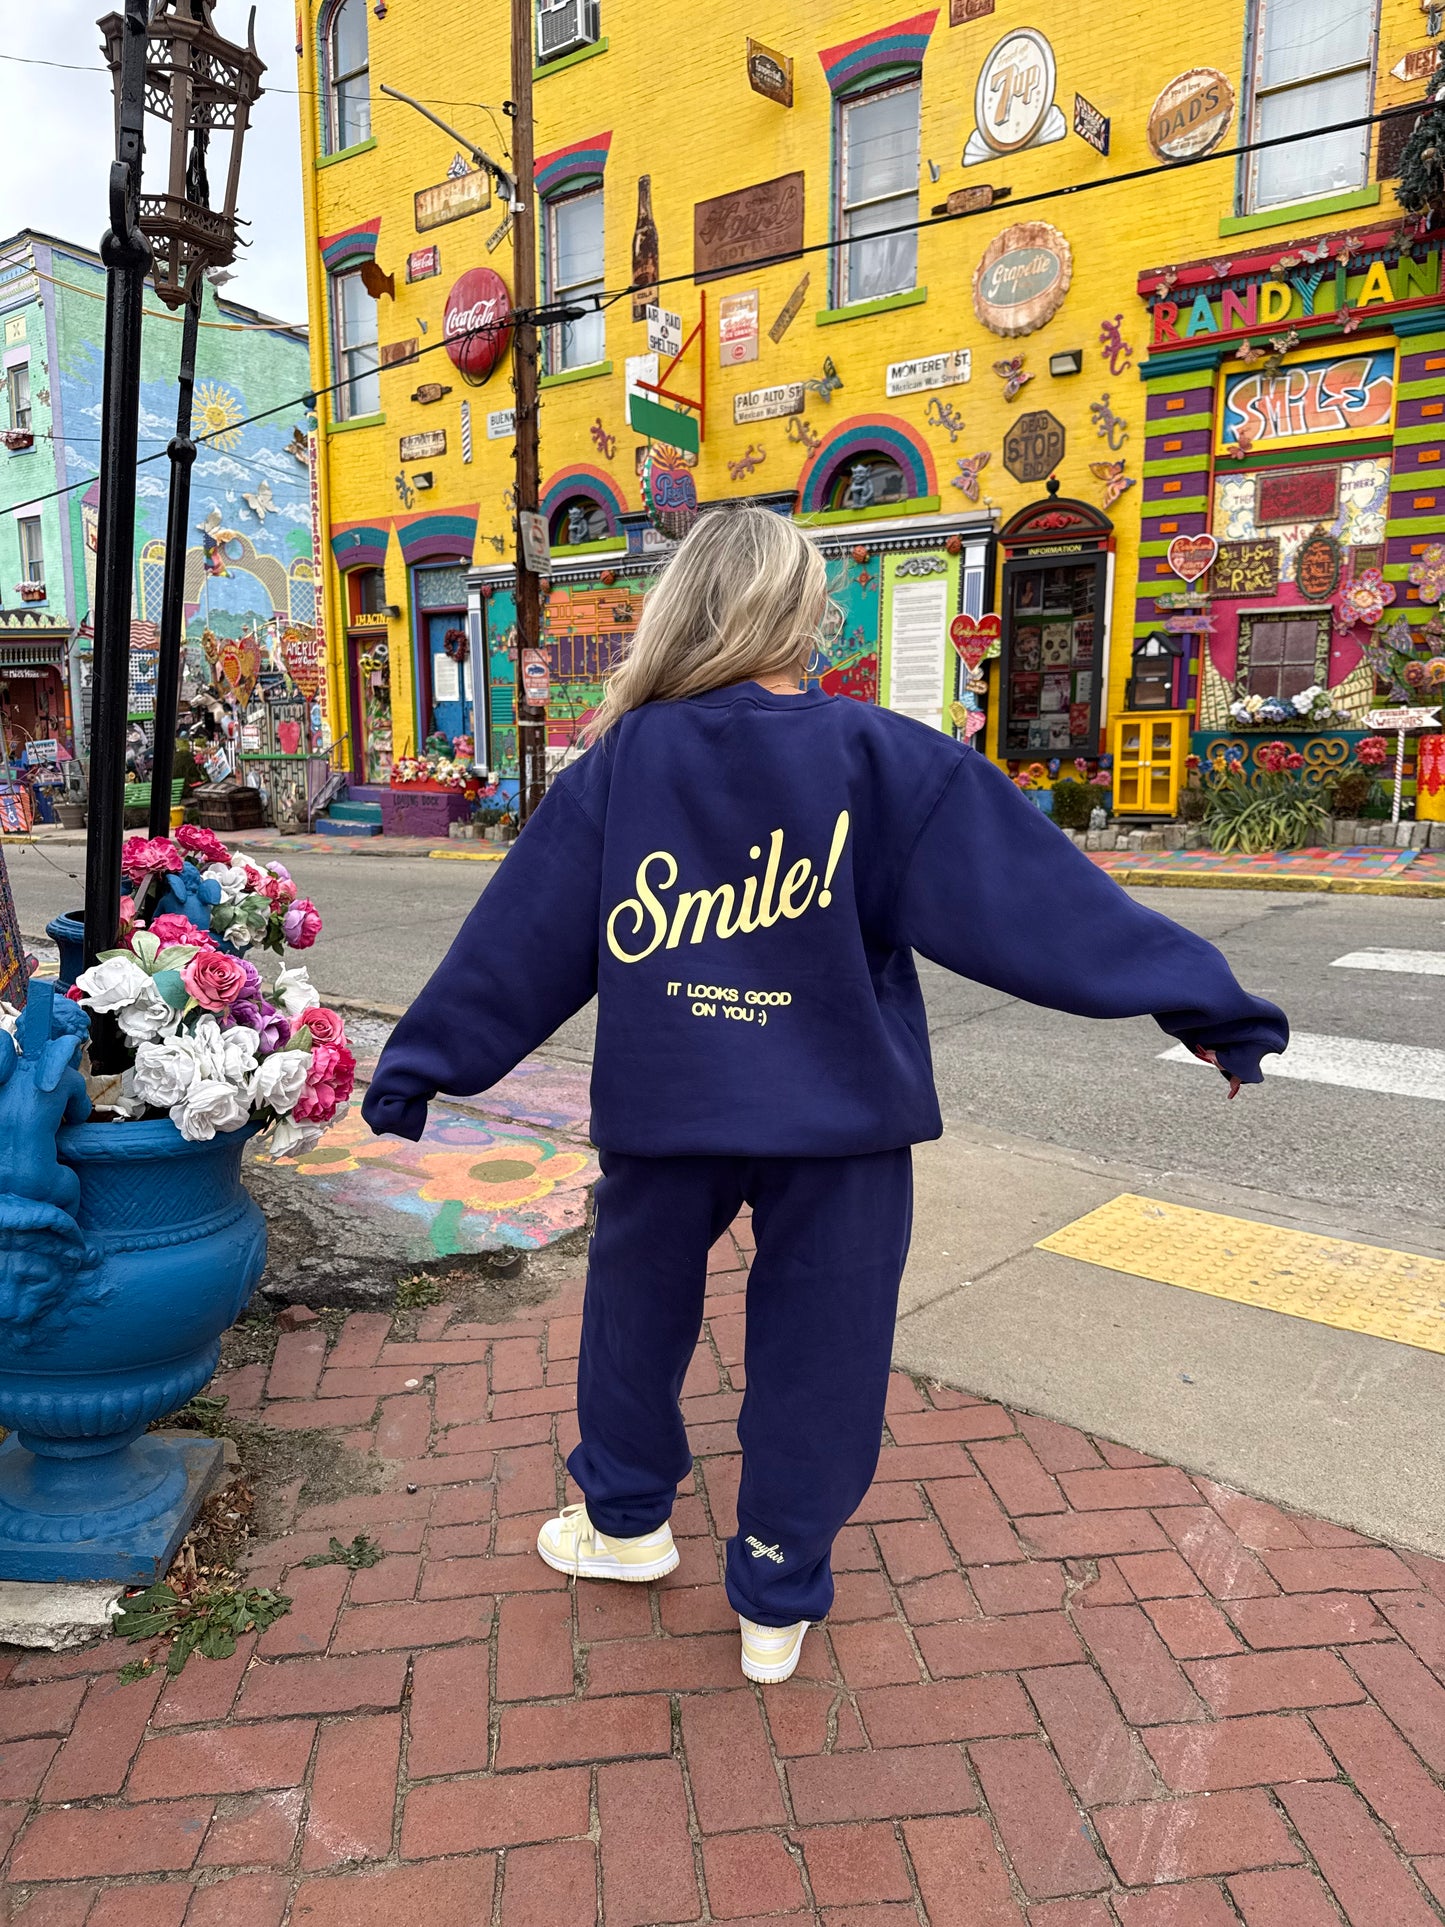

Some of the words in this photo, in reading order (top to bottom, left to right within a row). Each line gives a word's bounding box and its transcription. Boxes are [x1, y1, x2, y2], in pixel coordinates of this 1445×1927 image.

[1158, 85, 1219, 142] DAD'S
[988, 253, 1051, 298] Grapette
[1153, 249, 1445, 344] RANDYLAN
[650, 335, 680, 357] SHELTER
[891, 357, 950, 379] MONTEREY
[891, 381, 923, 393] Mexican
[737, 391, 760, 408] PALO
[763, 389, 784, 403] ALTO
[1021, 417, 1048, 432] DEAD
[1007, 432, 1060, 463] STOP
[1023, 461, 1044, 477] END
[1340, 477, 1376, 492] OTHERS
[1027, 544, 1083, 556] INFORMATION
[314, 585, 327, 659] WELCOME
[355, 613, 389, 627] IMAGIN
[286, 640, 319, 656] AMERIC
[319, 666, 328, 718] HOUSE
[606, 809, 850, 964] Smile!
[667, 982, 681, 996] IT
[687, 983, 739, 1002] LOOKS
[744, 991, 792, 1006] GOOD
[692, 1003, 716, 1017] ON
[722, 1005, 754, 1022] YOU
[745, 1535, 785, 1564] mayfair
